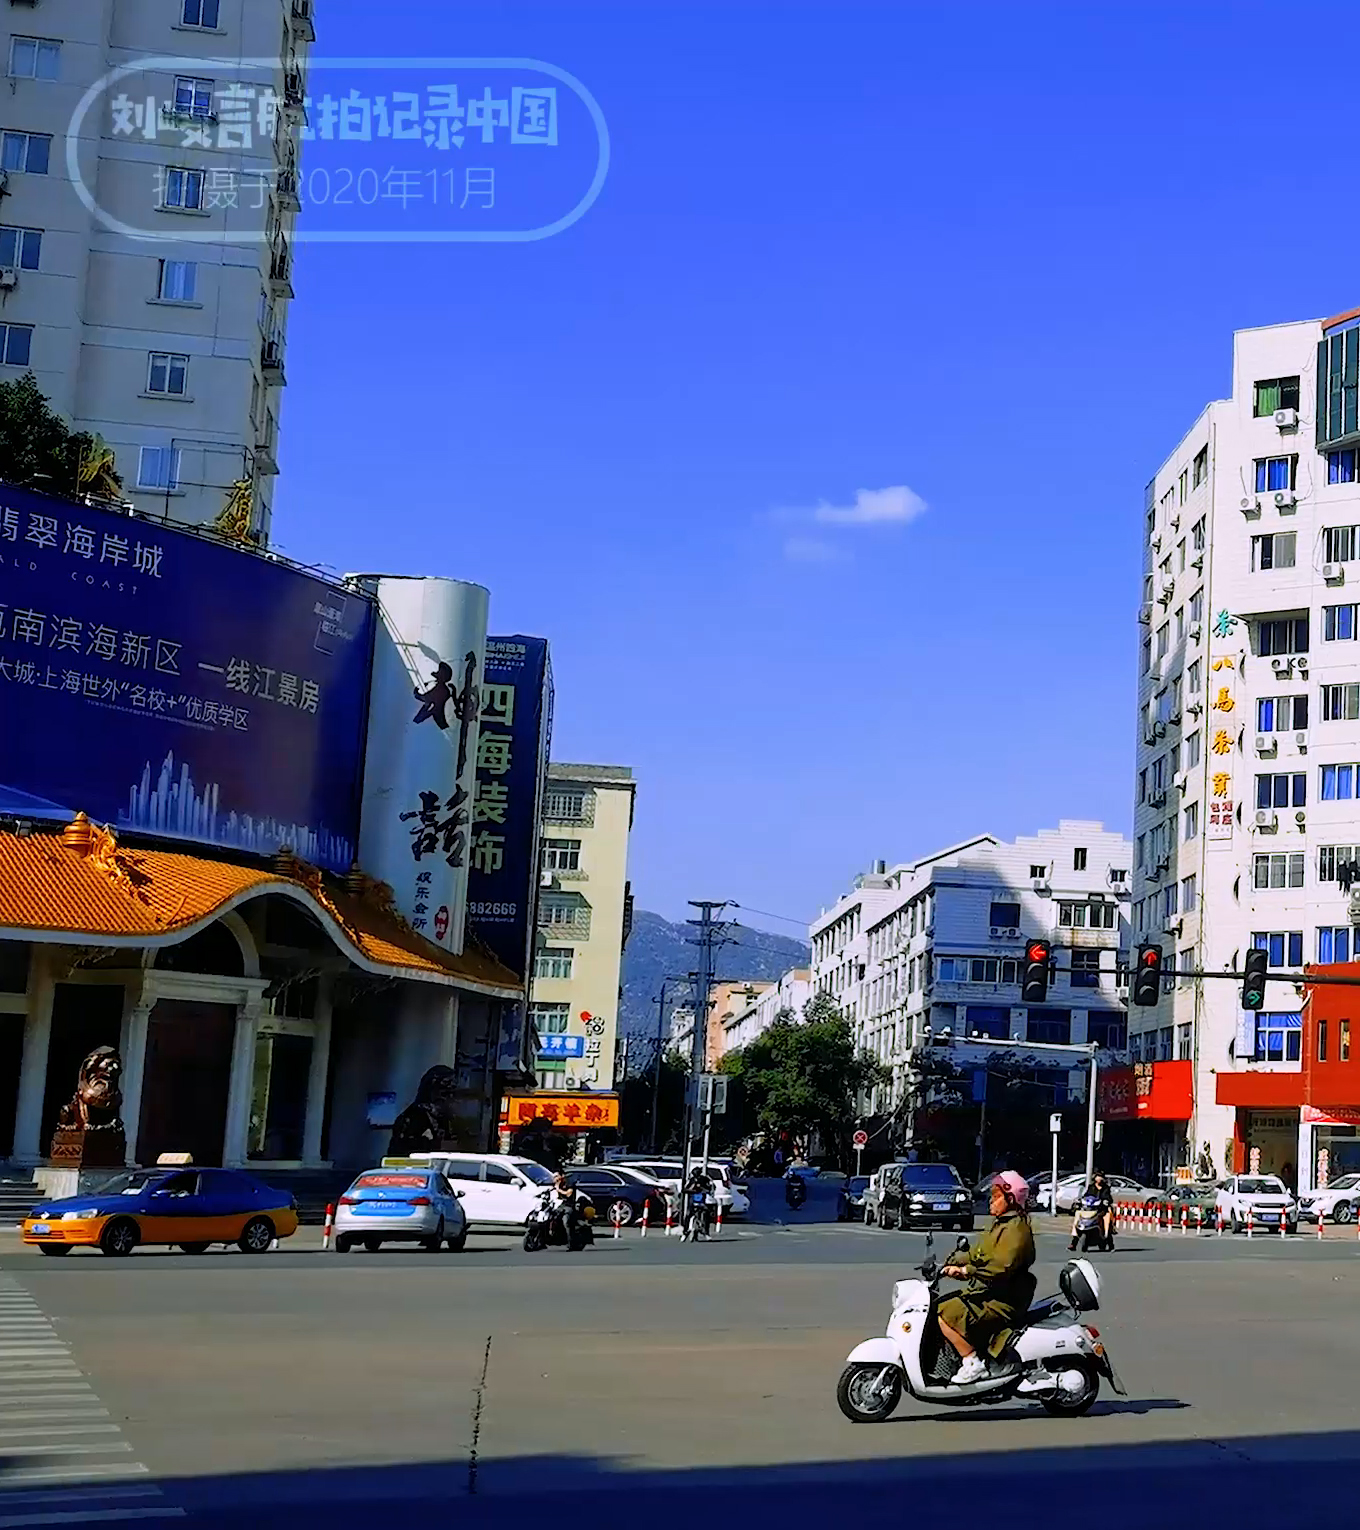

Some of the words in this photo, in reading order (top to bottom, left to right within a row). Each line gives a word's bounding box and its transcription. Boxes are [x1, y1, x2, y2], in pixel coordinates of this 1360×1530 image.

[71, 571, 138, 595] COAST
[0, 603, 183, 676] 南滨海新区
[198, 656, 321, 714] 一线江景房
